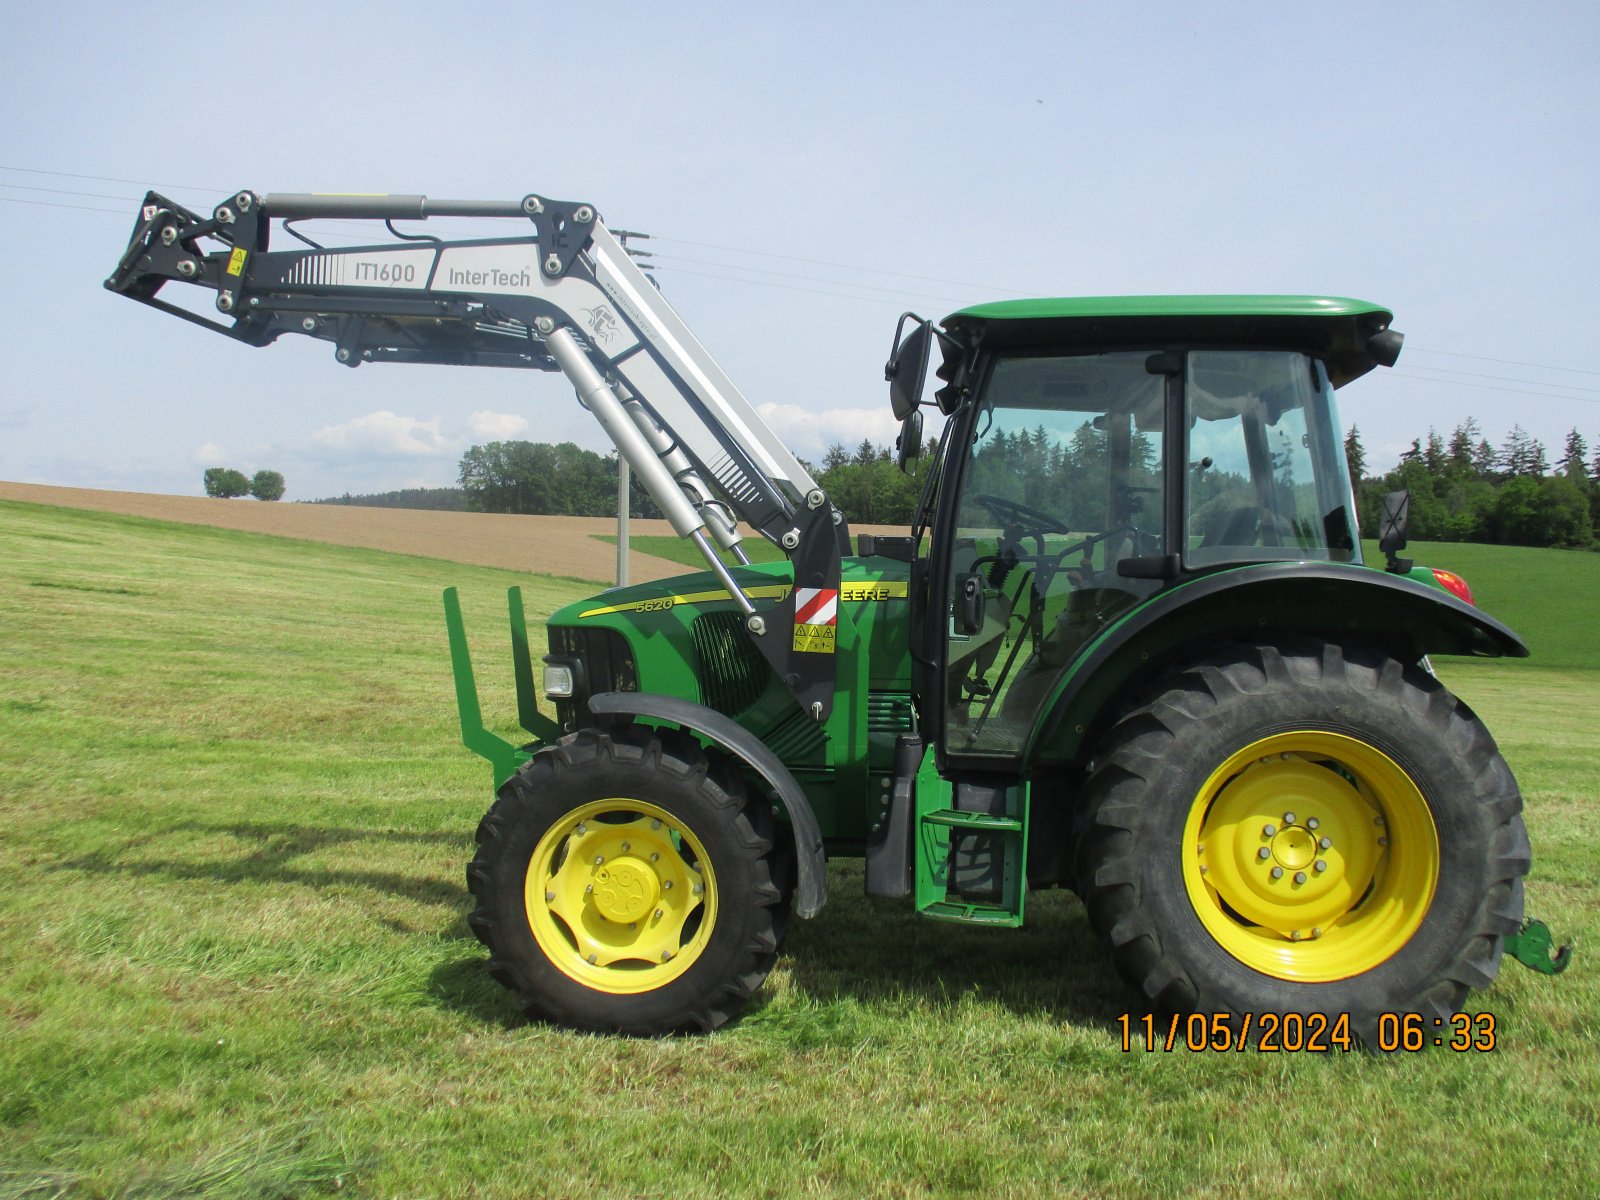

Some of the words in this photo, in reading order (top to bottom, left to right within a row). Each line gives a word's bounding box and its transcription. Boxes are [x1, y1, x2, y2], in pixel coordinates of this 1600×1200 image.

[355, 262, 415, 282] IT1600
[450, 267, 531, 287] InterTech
[842, 588, 889, 601] EERE
[635, 599, 674, 613] 5620
